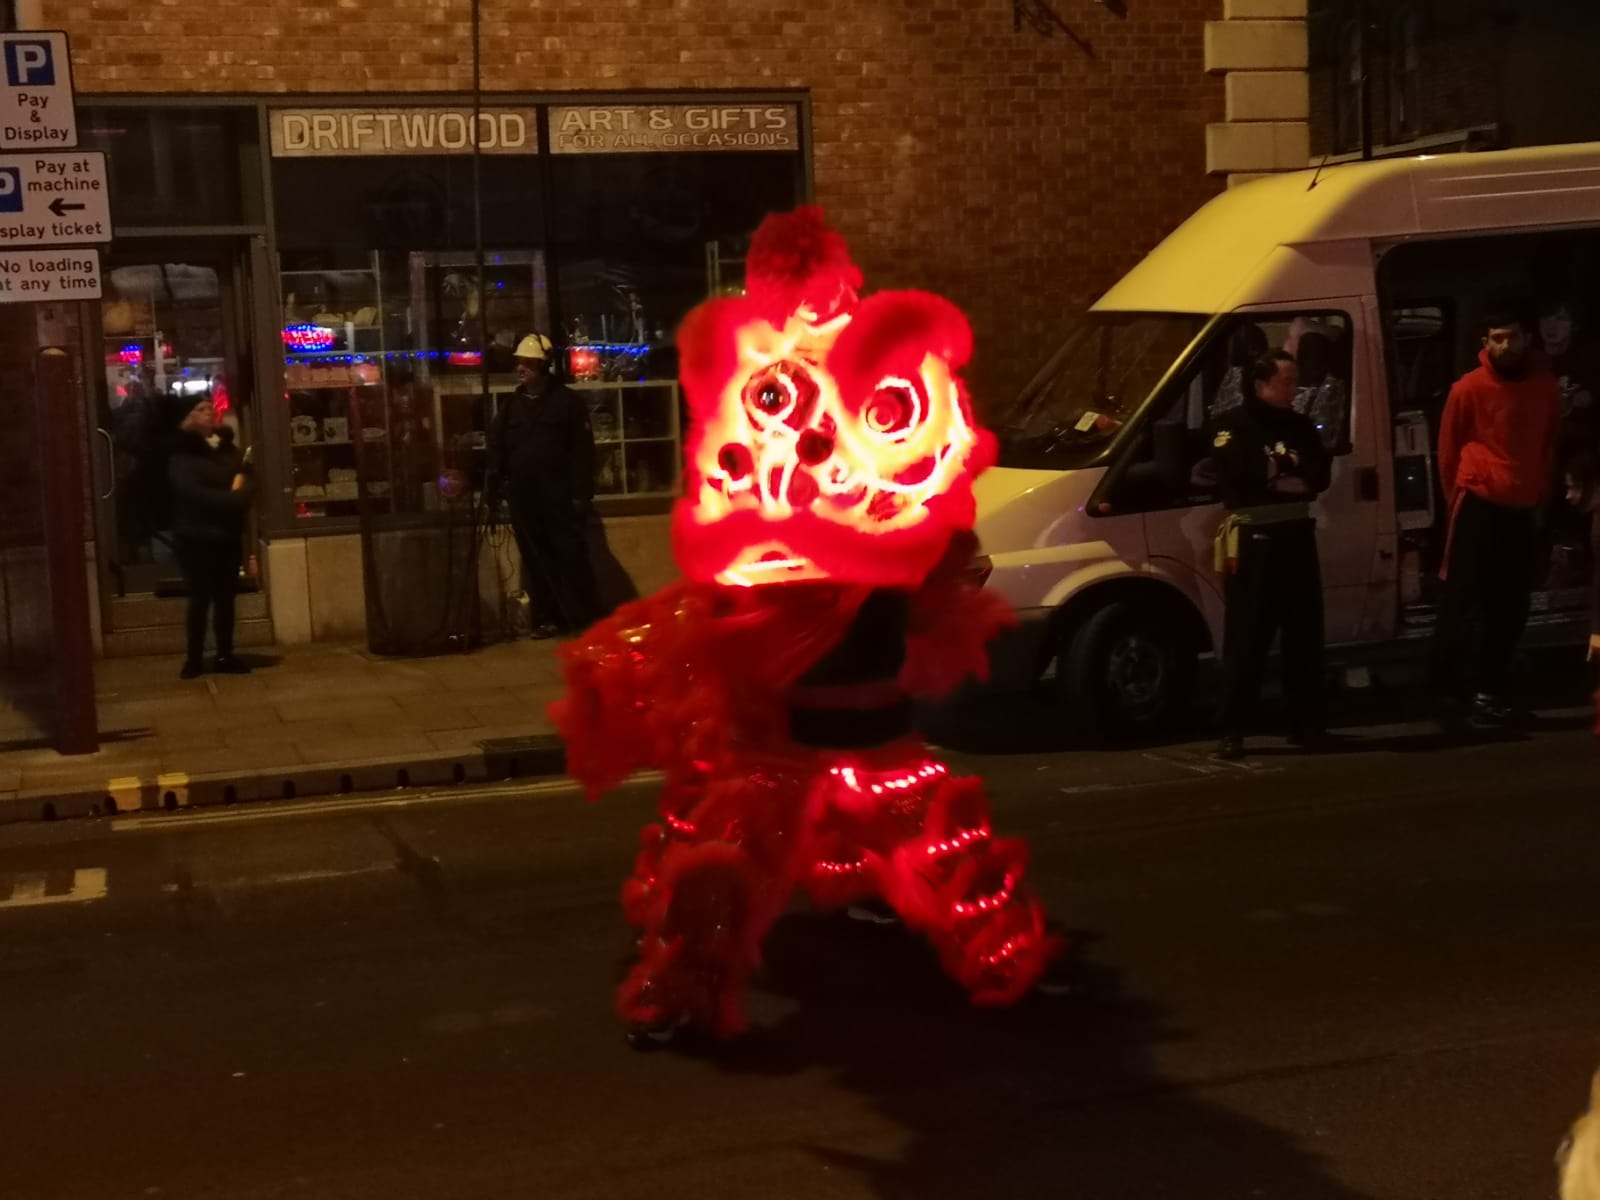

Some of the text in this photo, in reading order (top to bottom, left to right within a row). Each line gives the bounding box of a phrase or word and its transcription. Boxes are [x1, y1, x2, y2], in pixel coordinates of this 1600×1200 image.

[16, 44, 47, 83] P
[18, 93, 49, 108] Pay
[31, 110, 41, 123] &
[561, 107, 788, 132] ART & GIFTS
[5, 126, 69, 143] Display
[282, 113, 526, 150] DRIFTWOOD
[559, 131, 790, 149] FOR ALL OCCASIONS
[35, 160, 90, 175] Pay at
[28, 178, 100, 191] machine
[52, 222, 102, 236] ticket
[29, 259, 93, 272] loading
[20, 279, 50, 292] any
[59, 276, 97, 289] time
